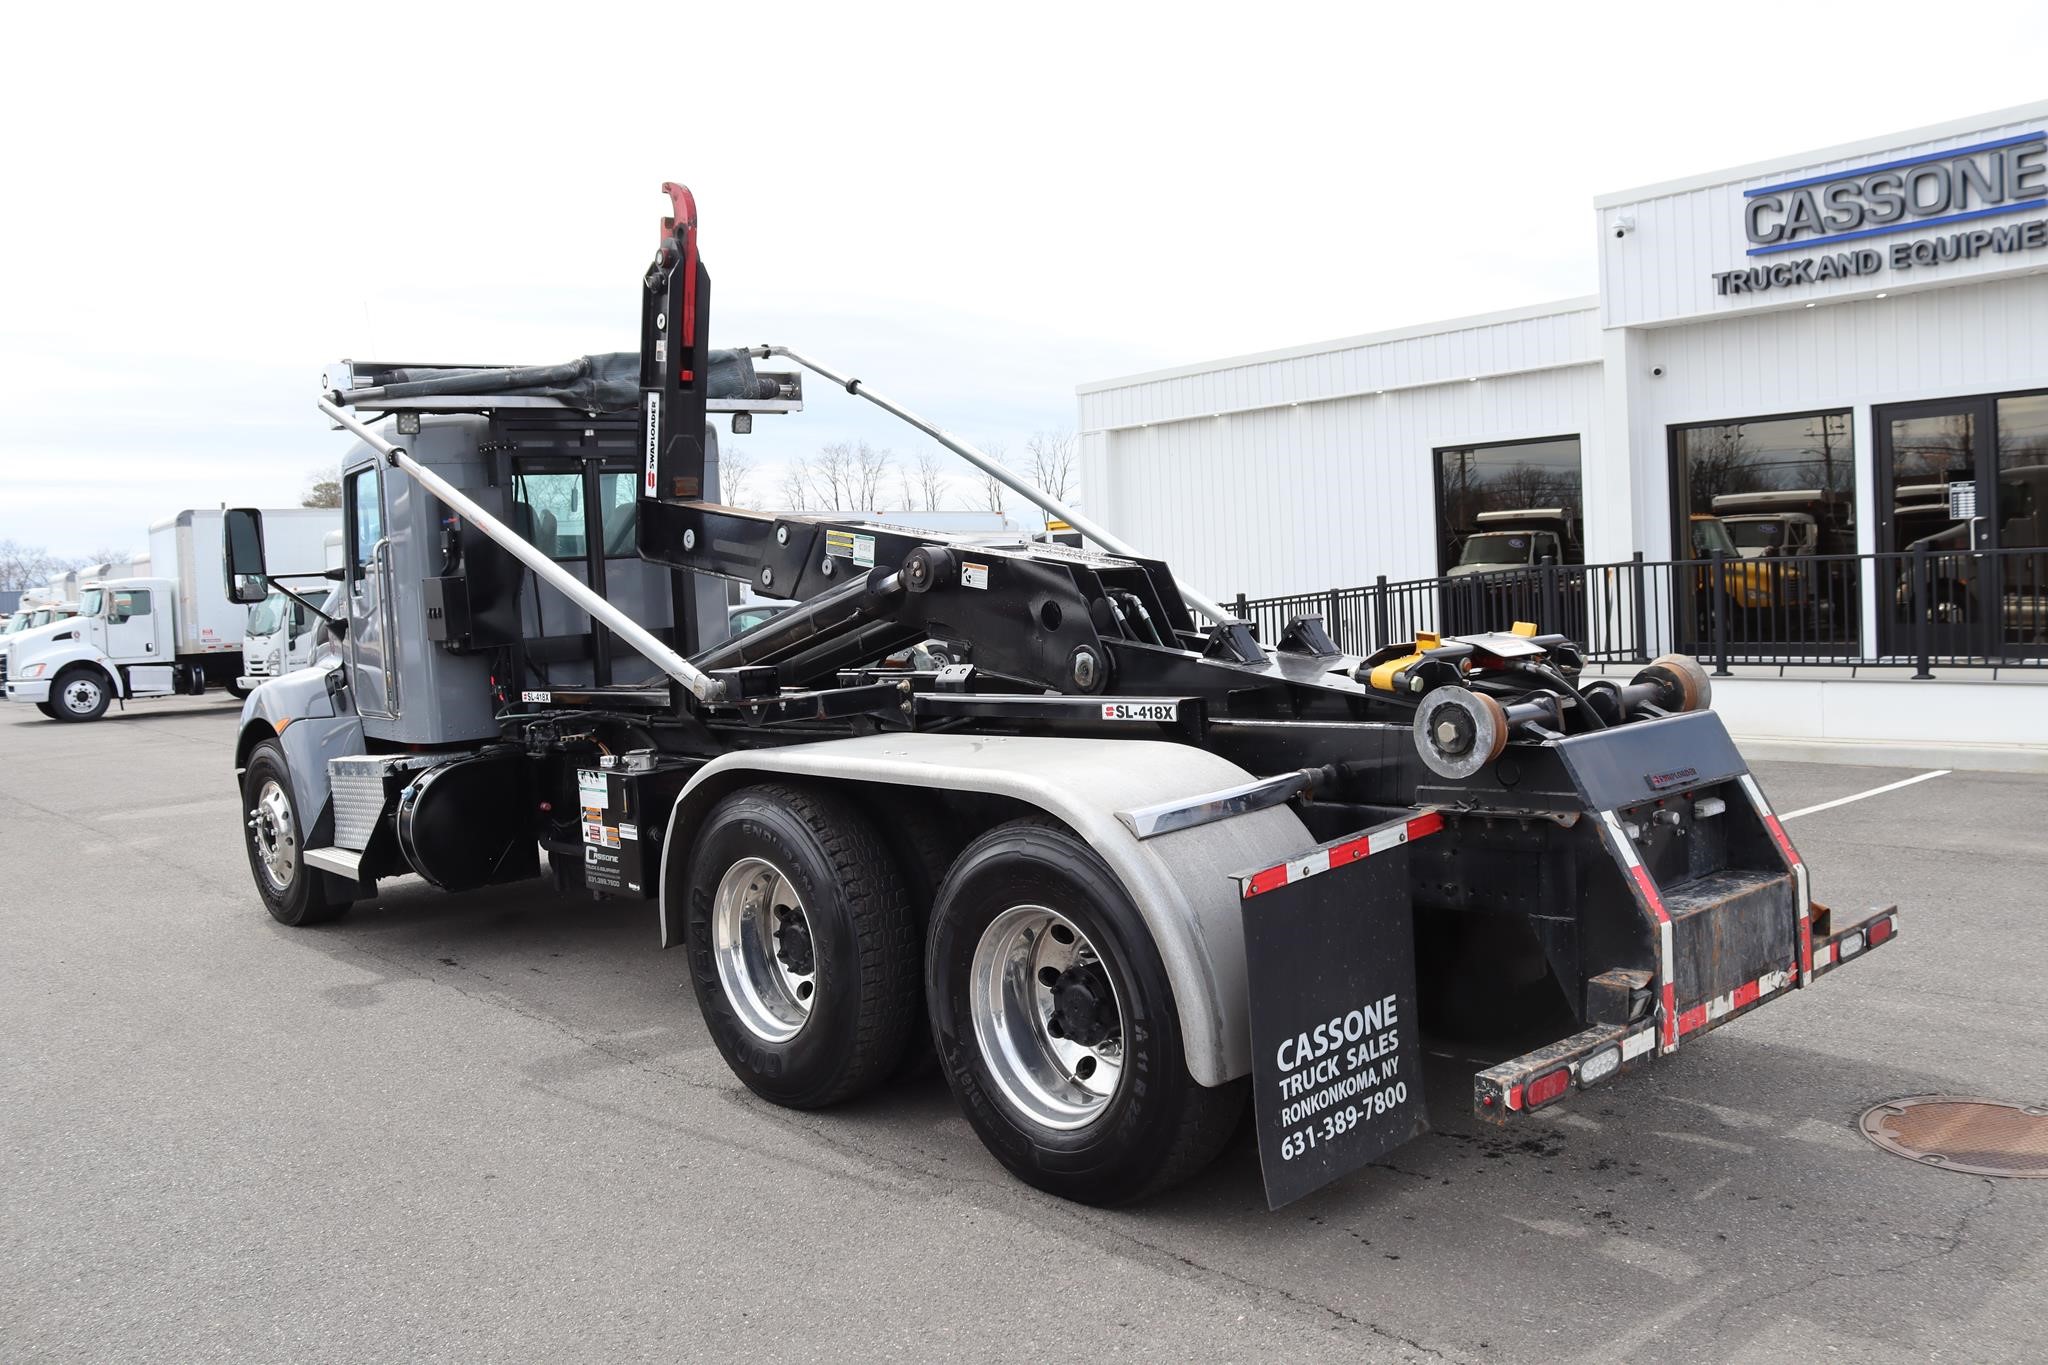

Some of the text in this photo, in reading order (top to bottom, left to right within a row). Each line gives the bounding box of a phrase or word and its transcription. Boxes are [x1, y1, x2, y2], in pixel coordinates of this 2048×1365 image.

[1745, 141, 2047, 244] CASSONE
[1711, 219, 2048, 296] TRUCK AND EQUIPME
[649, 401, 657, 470] SWAPLOADER
[528, 692, 550, 701] SL-418X
[1115, 704, 1173, 720] SL-418X
[1276, 994, 1398, 1072] CASSONE
[1278, 1029, 1399, 1101] TRUCK SALES
[1281, 1056, 1399, 1128] RONKONKOMA, NY
[1281, 1081, 1407, 1161] 631-389-7800
